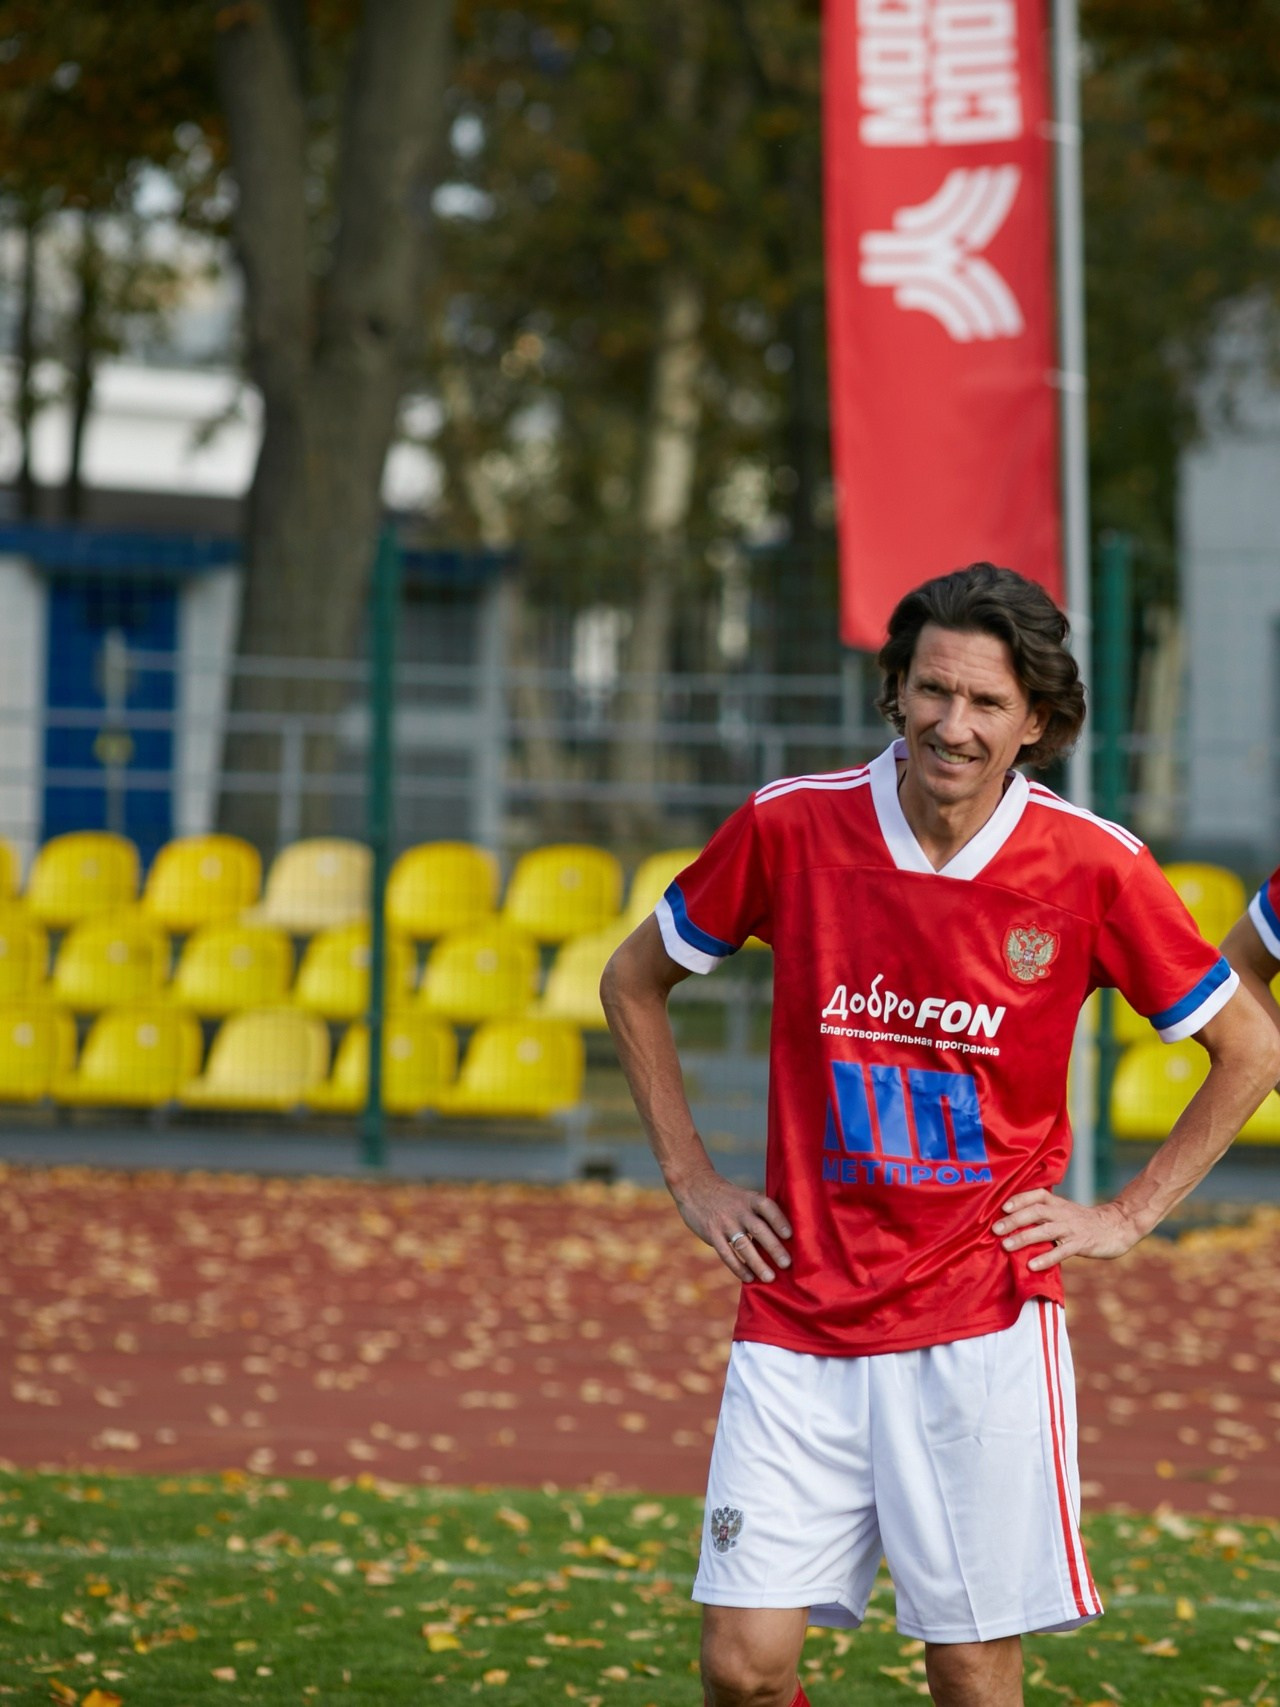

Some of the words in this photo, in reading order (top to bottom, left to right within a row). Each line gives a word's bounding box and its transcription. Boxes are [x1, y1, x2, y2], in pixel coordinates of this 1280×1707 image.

[820, 1022, 932, 1047] Благотворительная
[935, 1039, 1000, 1056] программа
[822, 1156, 993, 1185] МЕТПРОМ
